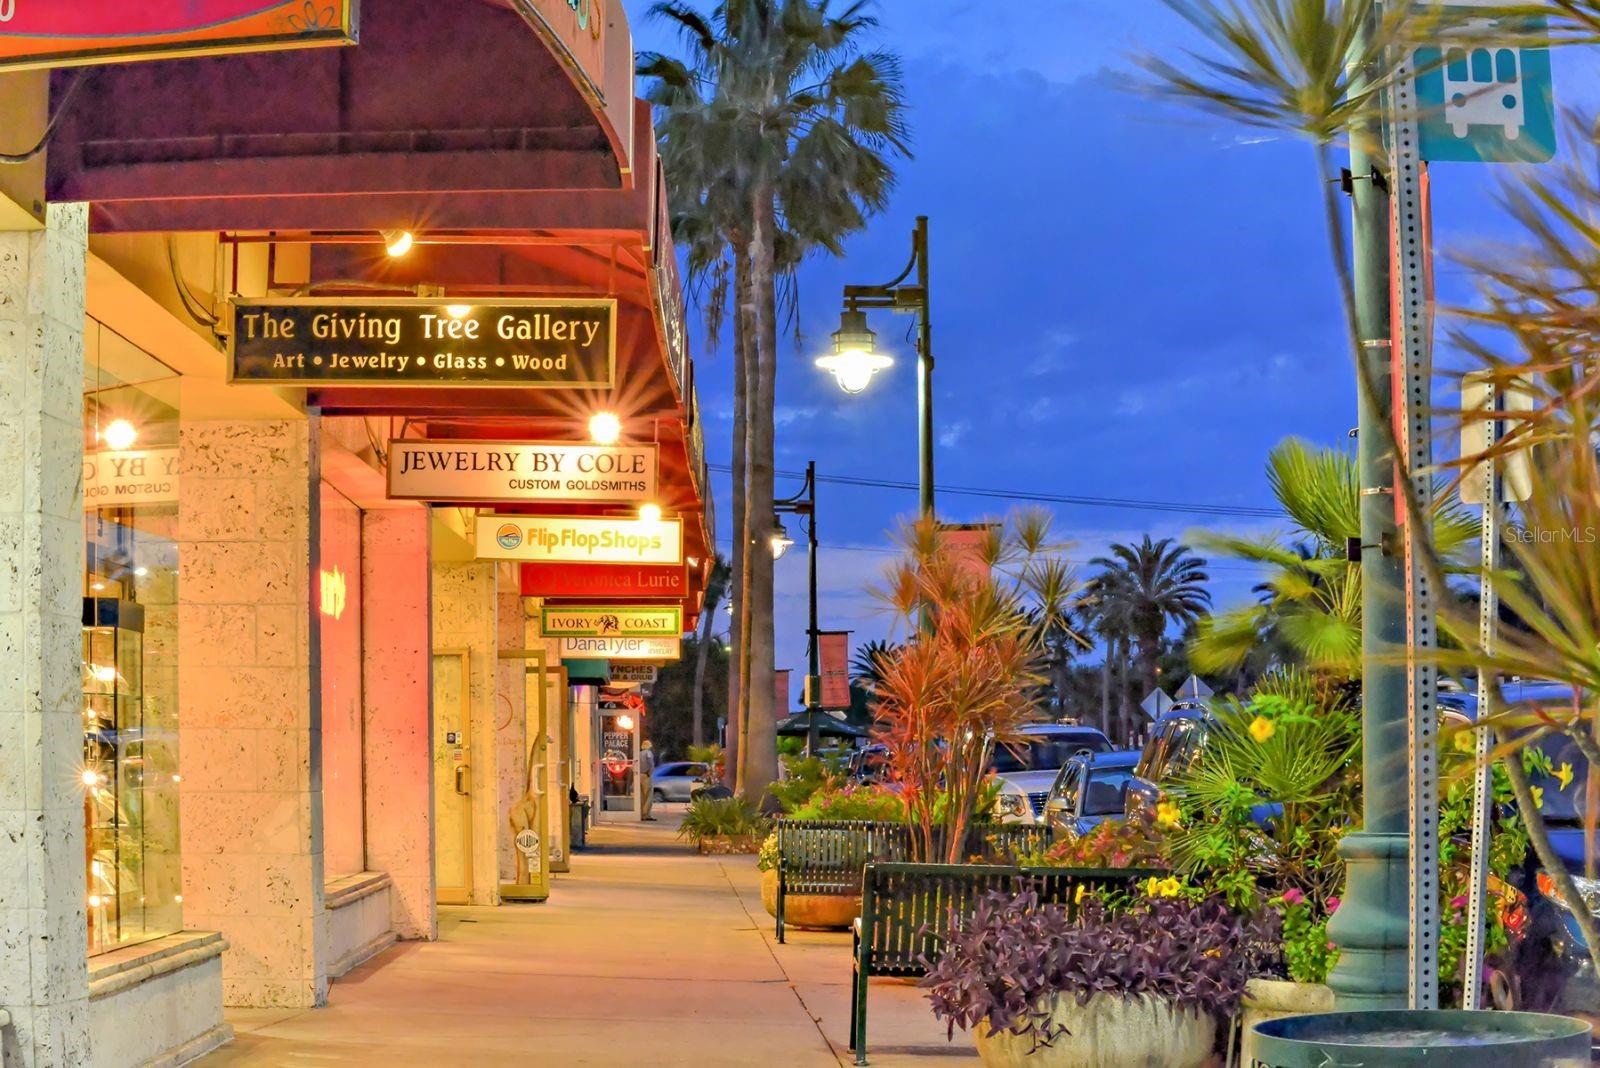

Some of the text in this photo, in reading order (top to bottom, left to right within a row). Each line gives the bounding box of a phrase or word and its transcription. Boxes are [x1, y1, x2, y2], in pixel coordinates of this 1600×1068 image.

[243, 313, 601, 347] The Giving Tree Gallery
[273, 353, 567, 372] Art Jewelry Glass Wood
[400, 451, 646, 475] JEWELRY BY COLE
[508, 478, 646, 492] CUSTOM GOLDSMITHS
[637, 570, 680, 588] Lurie
[552, 618, 668, 629] IVORY COAST
[609, 665, 653, 674] YNCHES
[603, 740, 629, 748] PALACE
